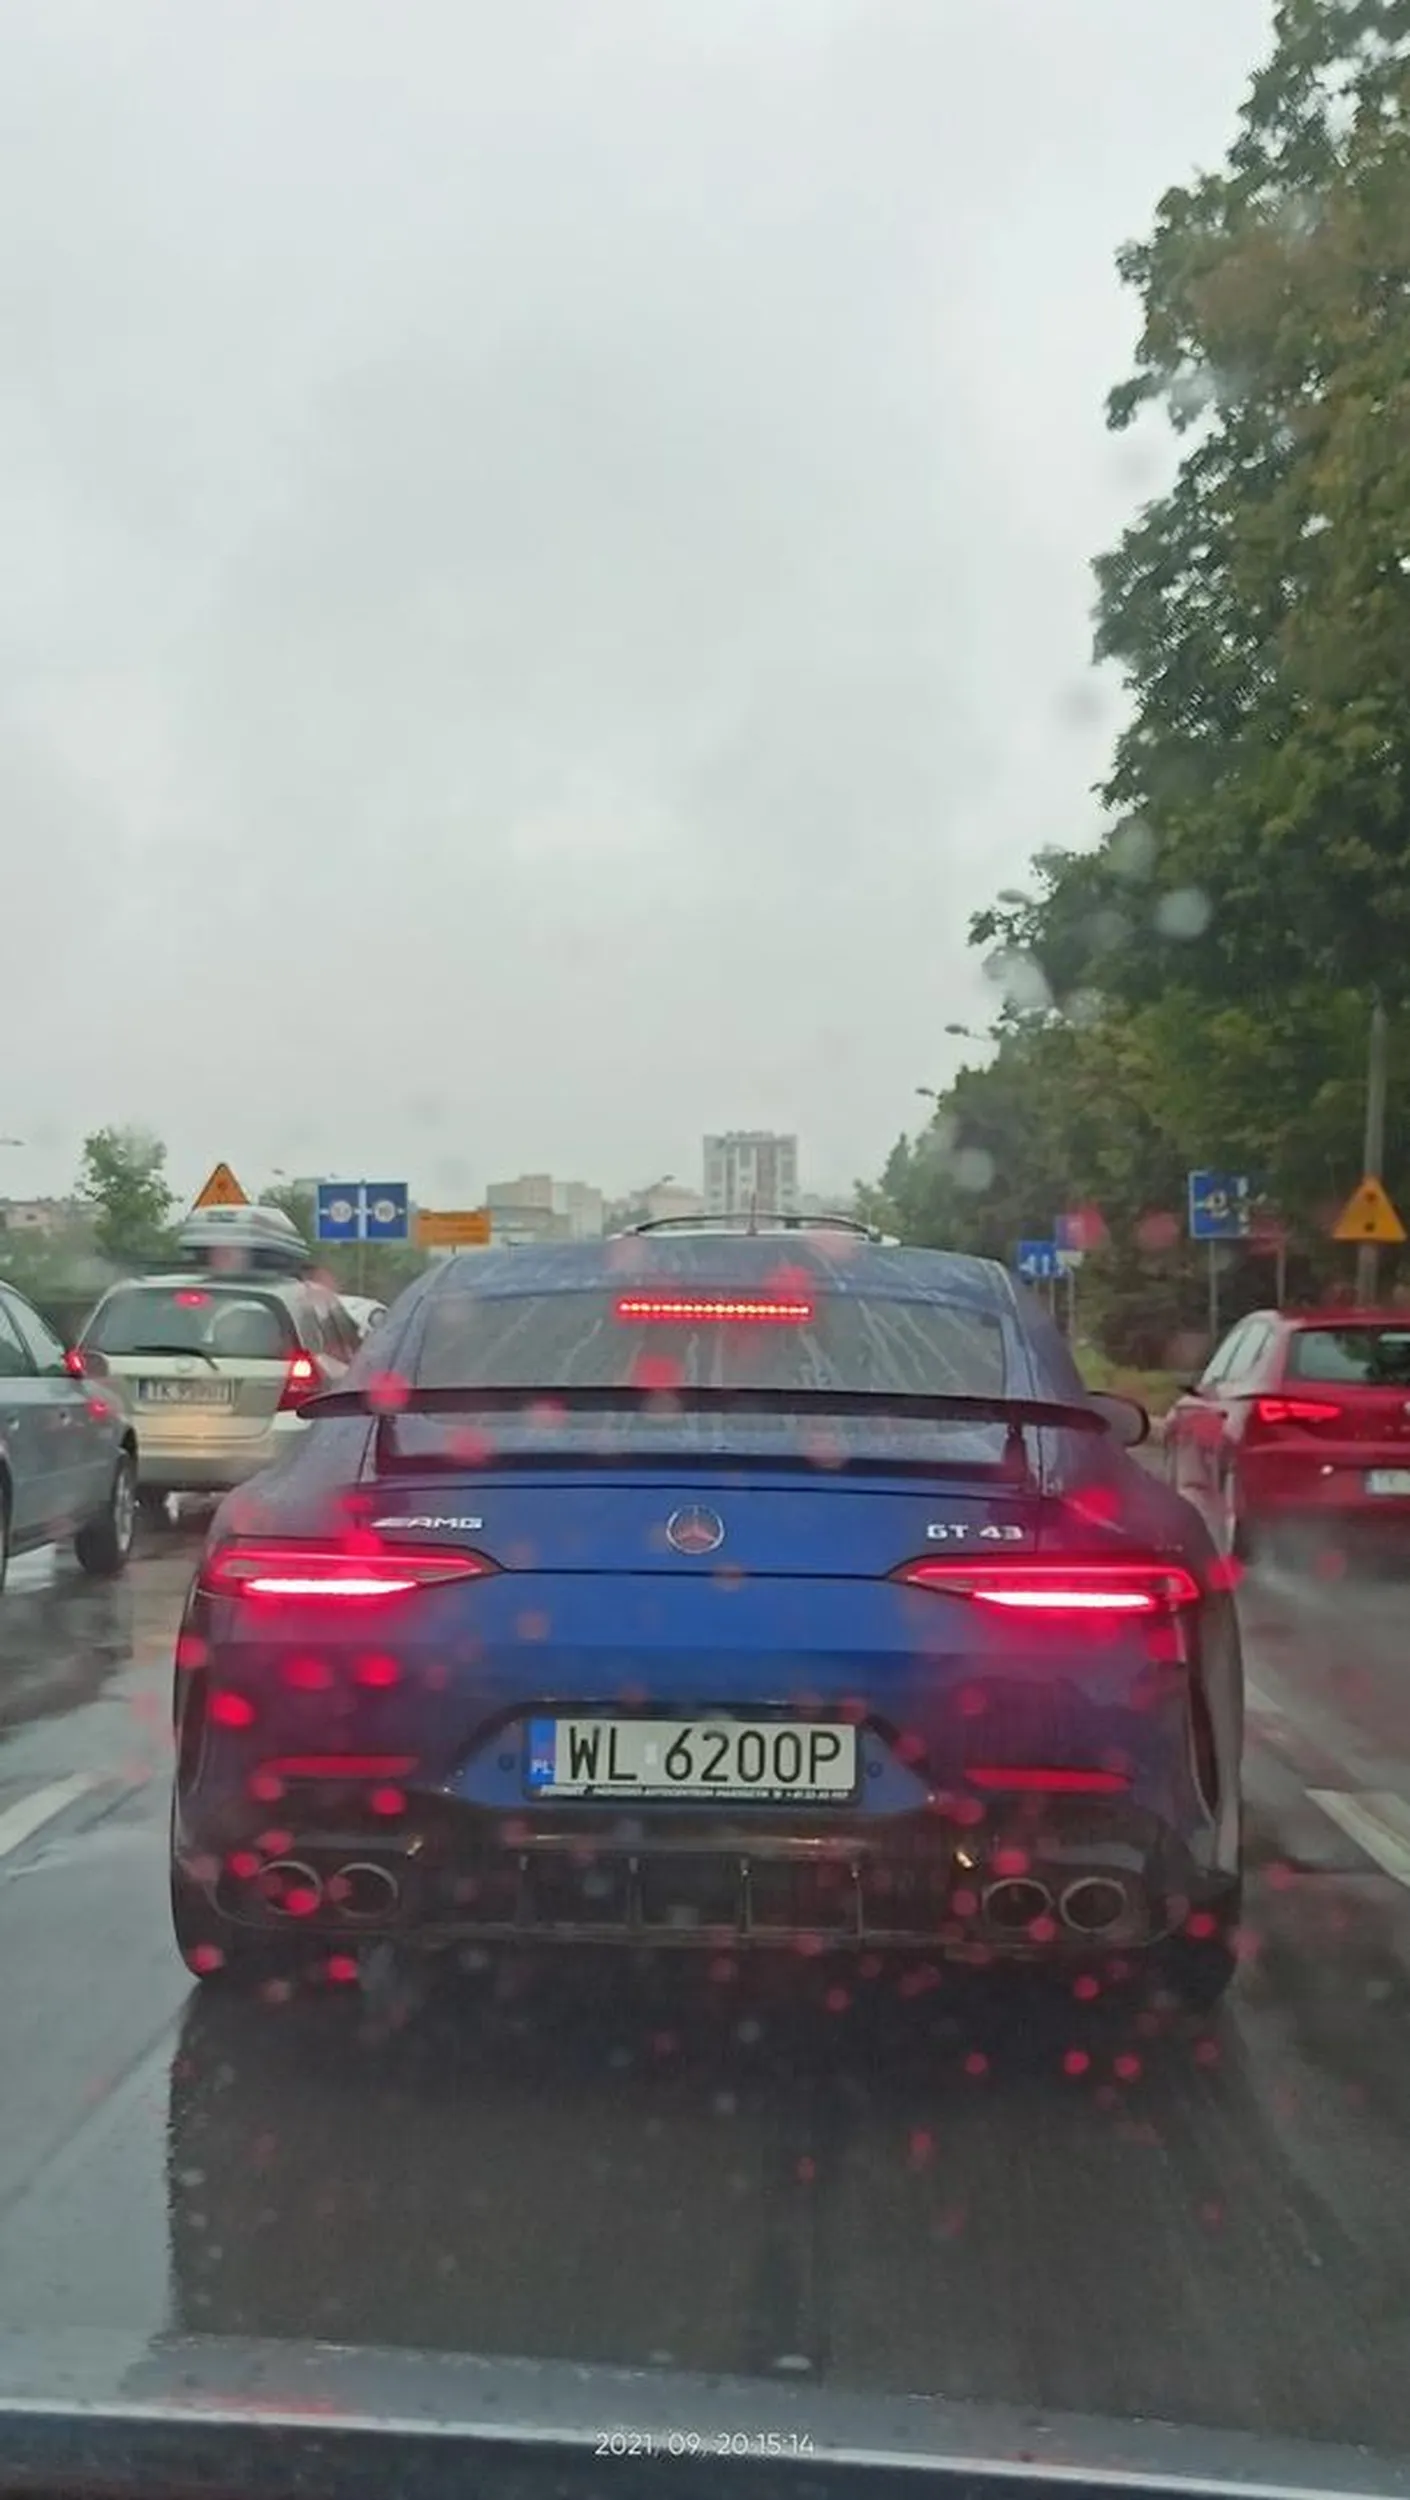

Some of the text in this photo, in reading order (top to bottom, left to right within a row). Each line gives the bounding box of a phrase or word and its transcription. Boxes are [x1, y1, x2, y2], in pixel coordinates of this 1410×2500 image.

[406, 1516, 484, 1529] AMG
[926, 1523, 1023, 1540] GT 43
[569, 1724, 841, 1785] WL 6200P
